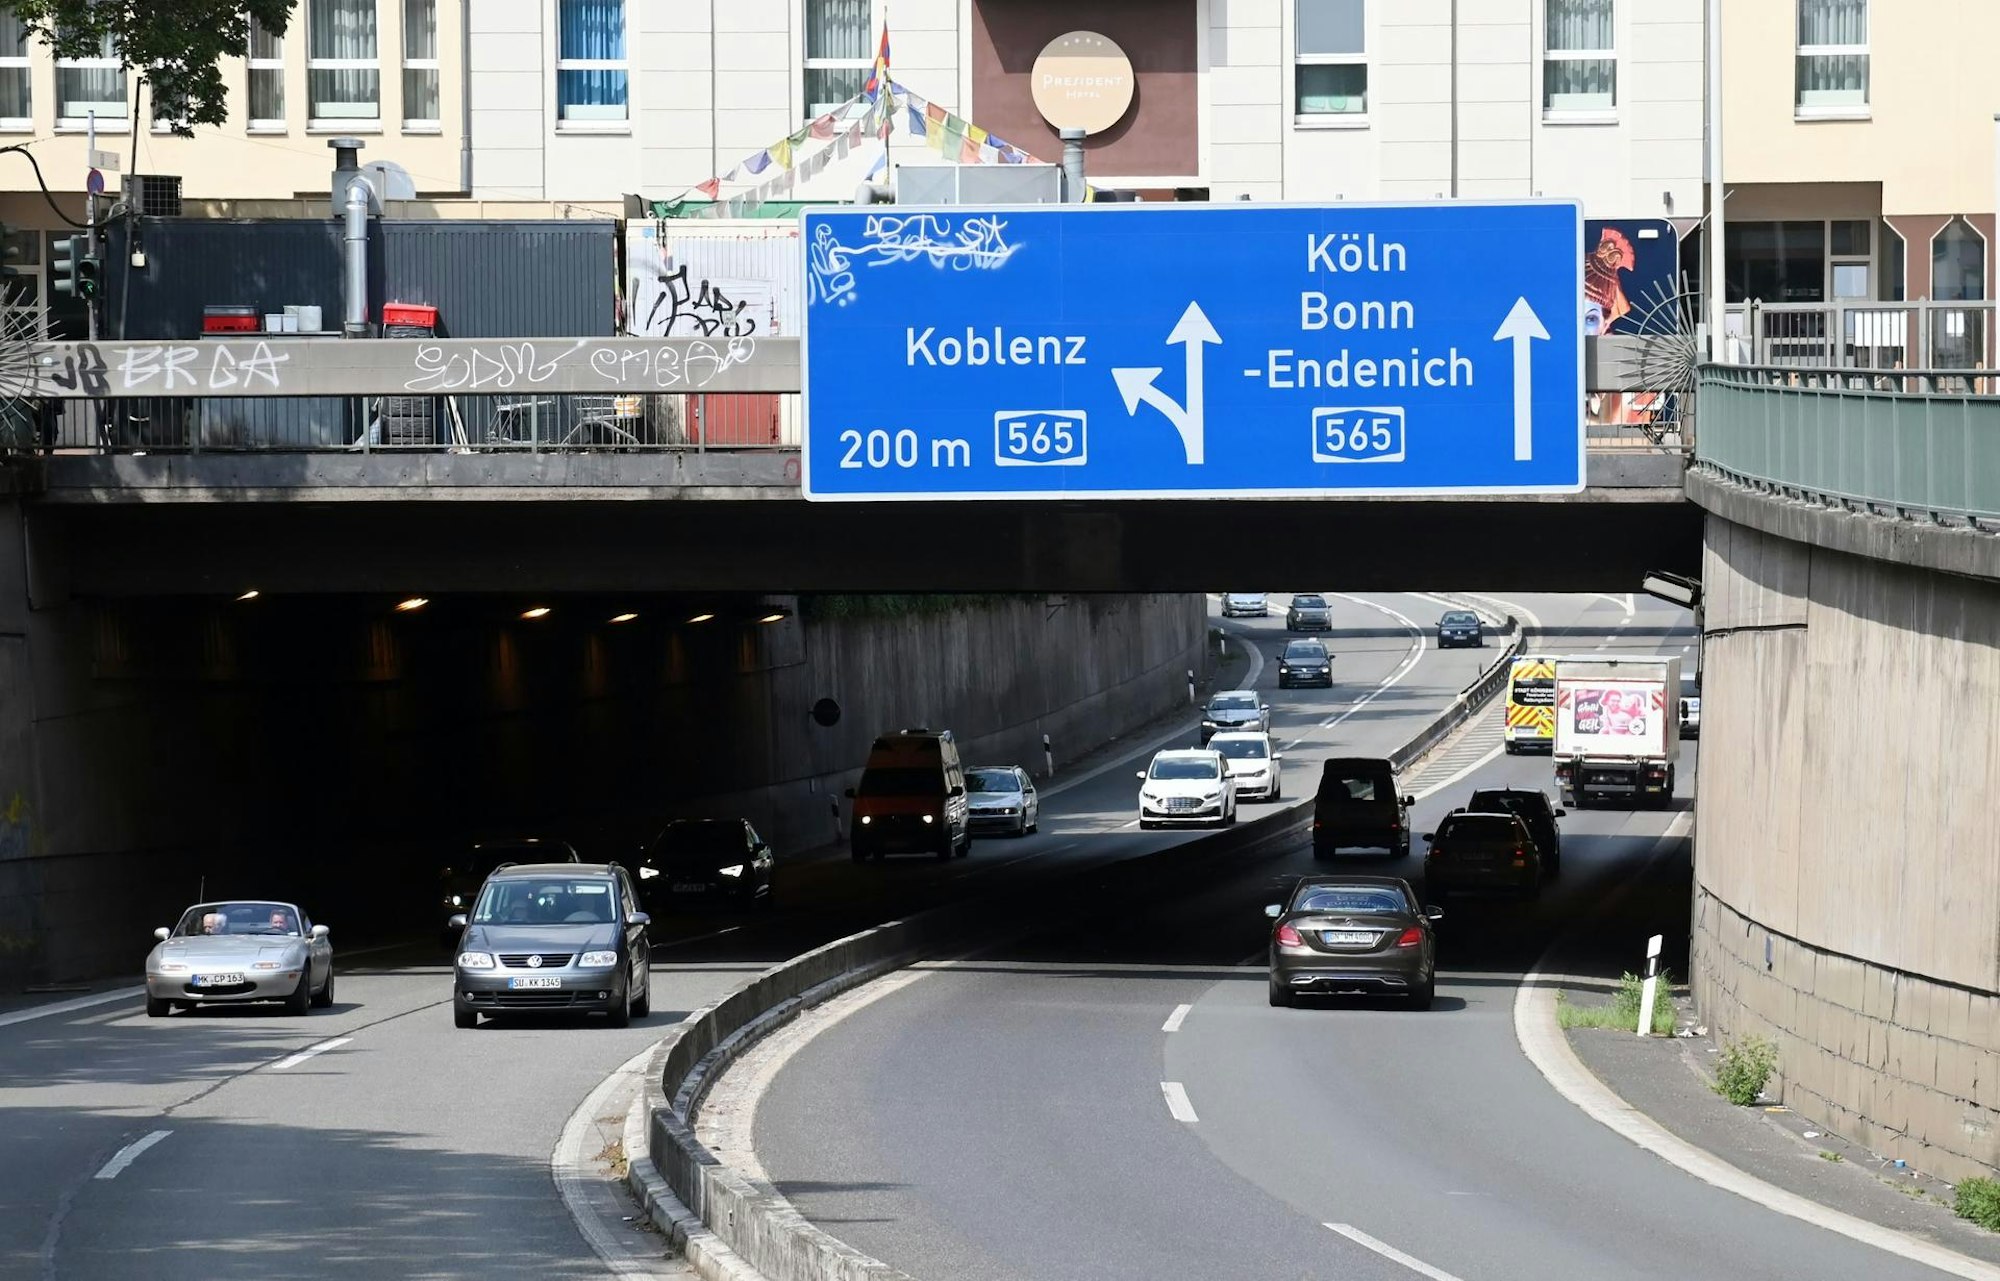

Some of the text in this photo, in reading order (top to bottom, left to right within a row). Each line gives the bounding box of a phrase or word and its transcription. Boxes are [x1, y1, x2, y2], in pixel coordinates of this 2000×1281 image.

[1308, 233, 1406, 273] Köln
[1302, 292, 1414, 330] Bonn
[906, 327, 1086, 367] Koblenz
[1245, 349, 1474, 388] -Endenich
[840, 429, 970, 469] 200 m
[1009, 422, 1074, 455] 565
[1326, 418, 1391, 452] 565
